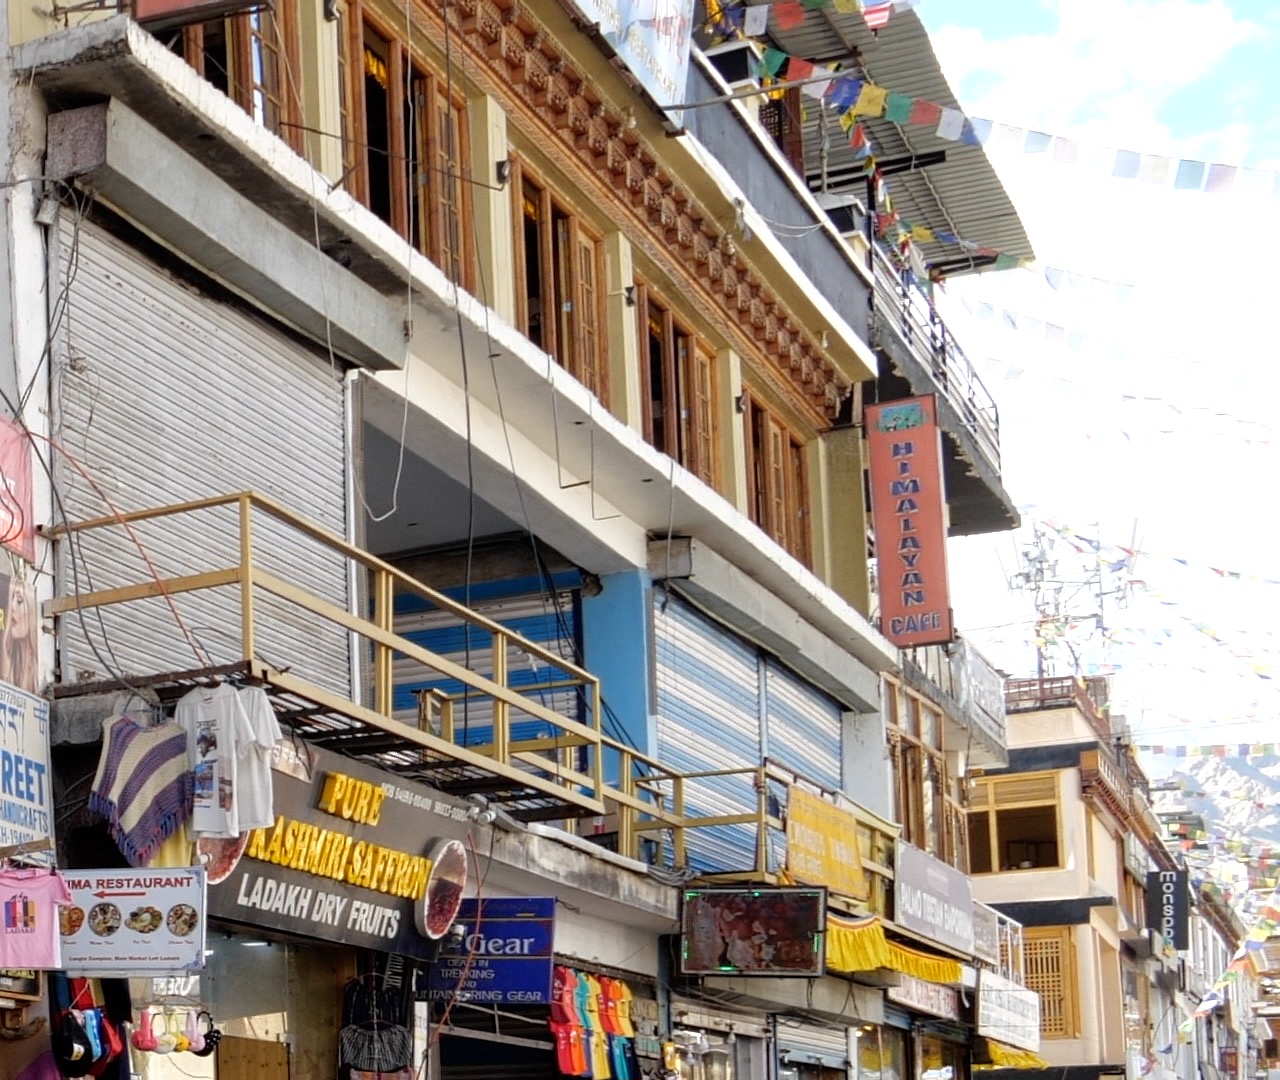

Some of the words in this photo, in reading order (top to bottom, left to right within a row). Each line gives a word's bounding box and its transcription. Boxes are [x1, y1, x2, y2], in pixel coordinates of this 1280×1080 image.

[890, 441, 925, 607] HIMALAYAN
[890, 611, 942, 636] CAFE
[325, 773, 385, 826] PURE
[96, 877, 193, 889] RESTAURANT
[238, 873, 313, 922] LADAKH
[313, 893, 346, 927] DRY
[349, 901, 400, 939] FRUITS
[465, 933, 535, 955] Gear
[507, 991, 542, 1001] GEAR
